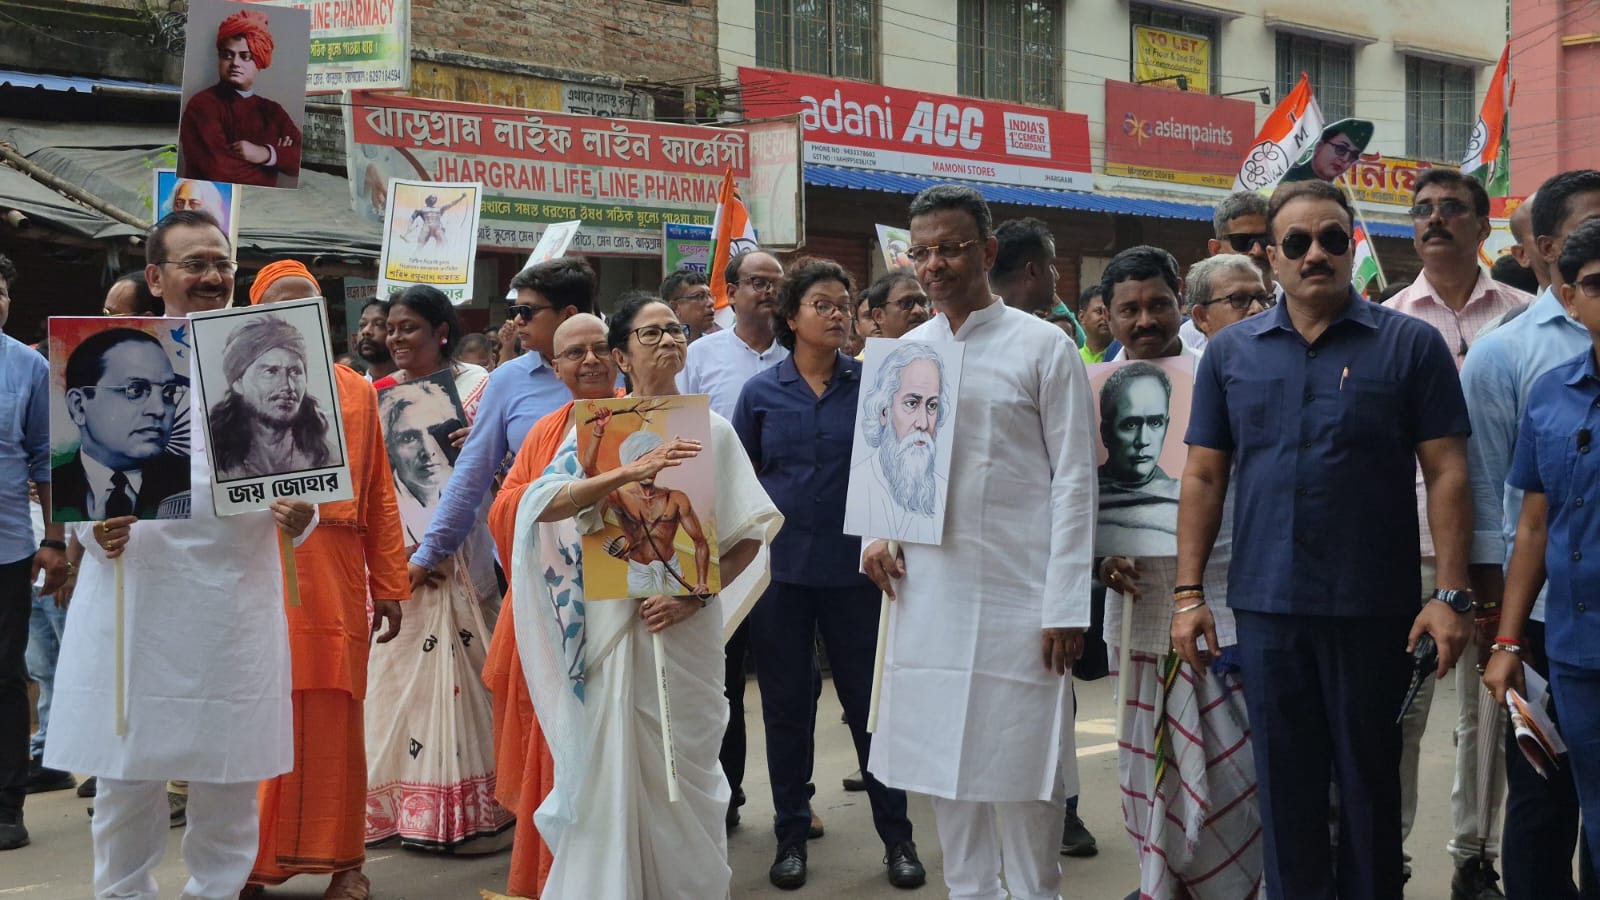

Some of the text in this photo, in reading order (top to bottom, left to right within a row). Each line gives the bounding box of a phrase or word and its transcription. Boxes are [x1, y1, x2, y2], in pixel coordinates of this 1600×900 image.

[333, 0, 394, 28] PHARMACY
[1147, 31, 1198, 53] TO LET
[800, 89, 984, 150] adani ACC
[1009, 119, 1046, 135] INDIA'S
[364, 106, 482, 147] ঝাড়গ্রাম
[492, 115, 572, 154] লাইফ
[581, 122, 650, 161] লাইন
[659, 134, 745, 170] ফার্মেসী
[1018, 132, 1046, 143] CEMENT
[1155, 116, 1233, 152] asianpaints
[811, 145, 831, 154] PHONE
[1015, 140, 1047, 152] COMPANY
[433, 157, 546, 193] JHARGRAM
[553, 167, 593, 196] LIFE
[598, 171, 639, 199] LINE
[645, 174, 740, 204] PHARMA
[932, 161, 996, 178] MAMONI STORES
[481, 201, 511, 215] এখানে
[226, 472, 339, 504] জয় জোহার
